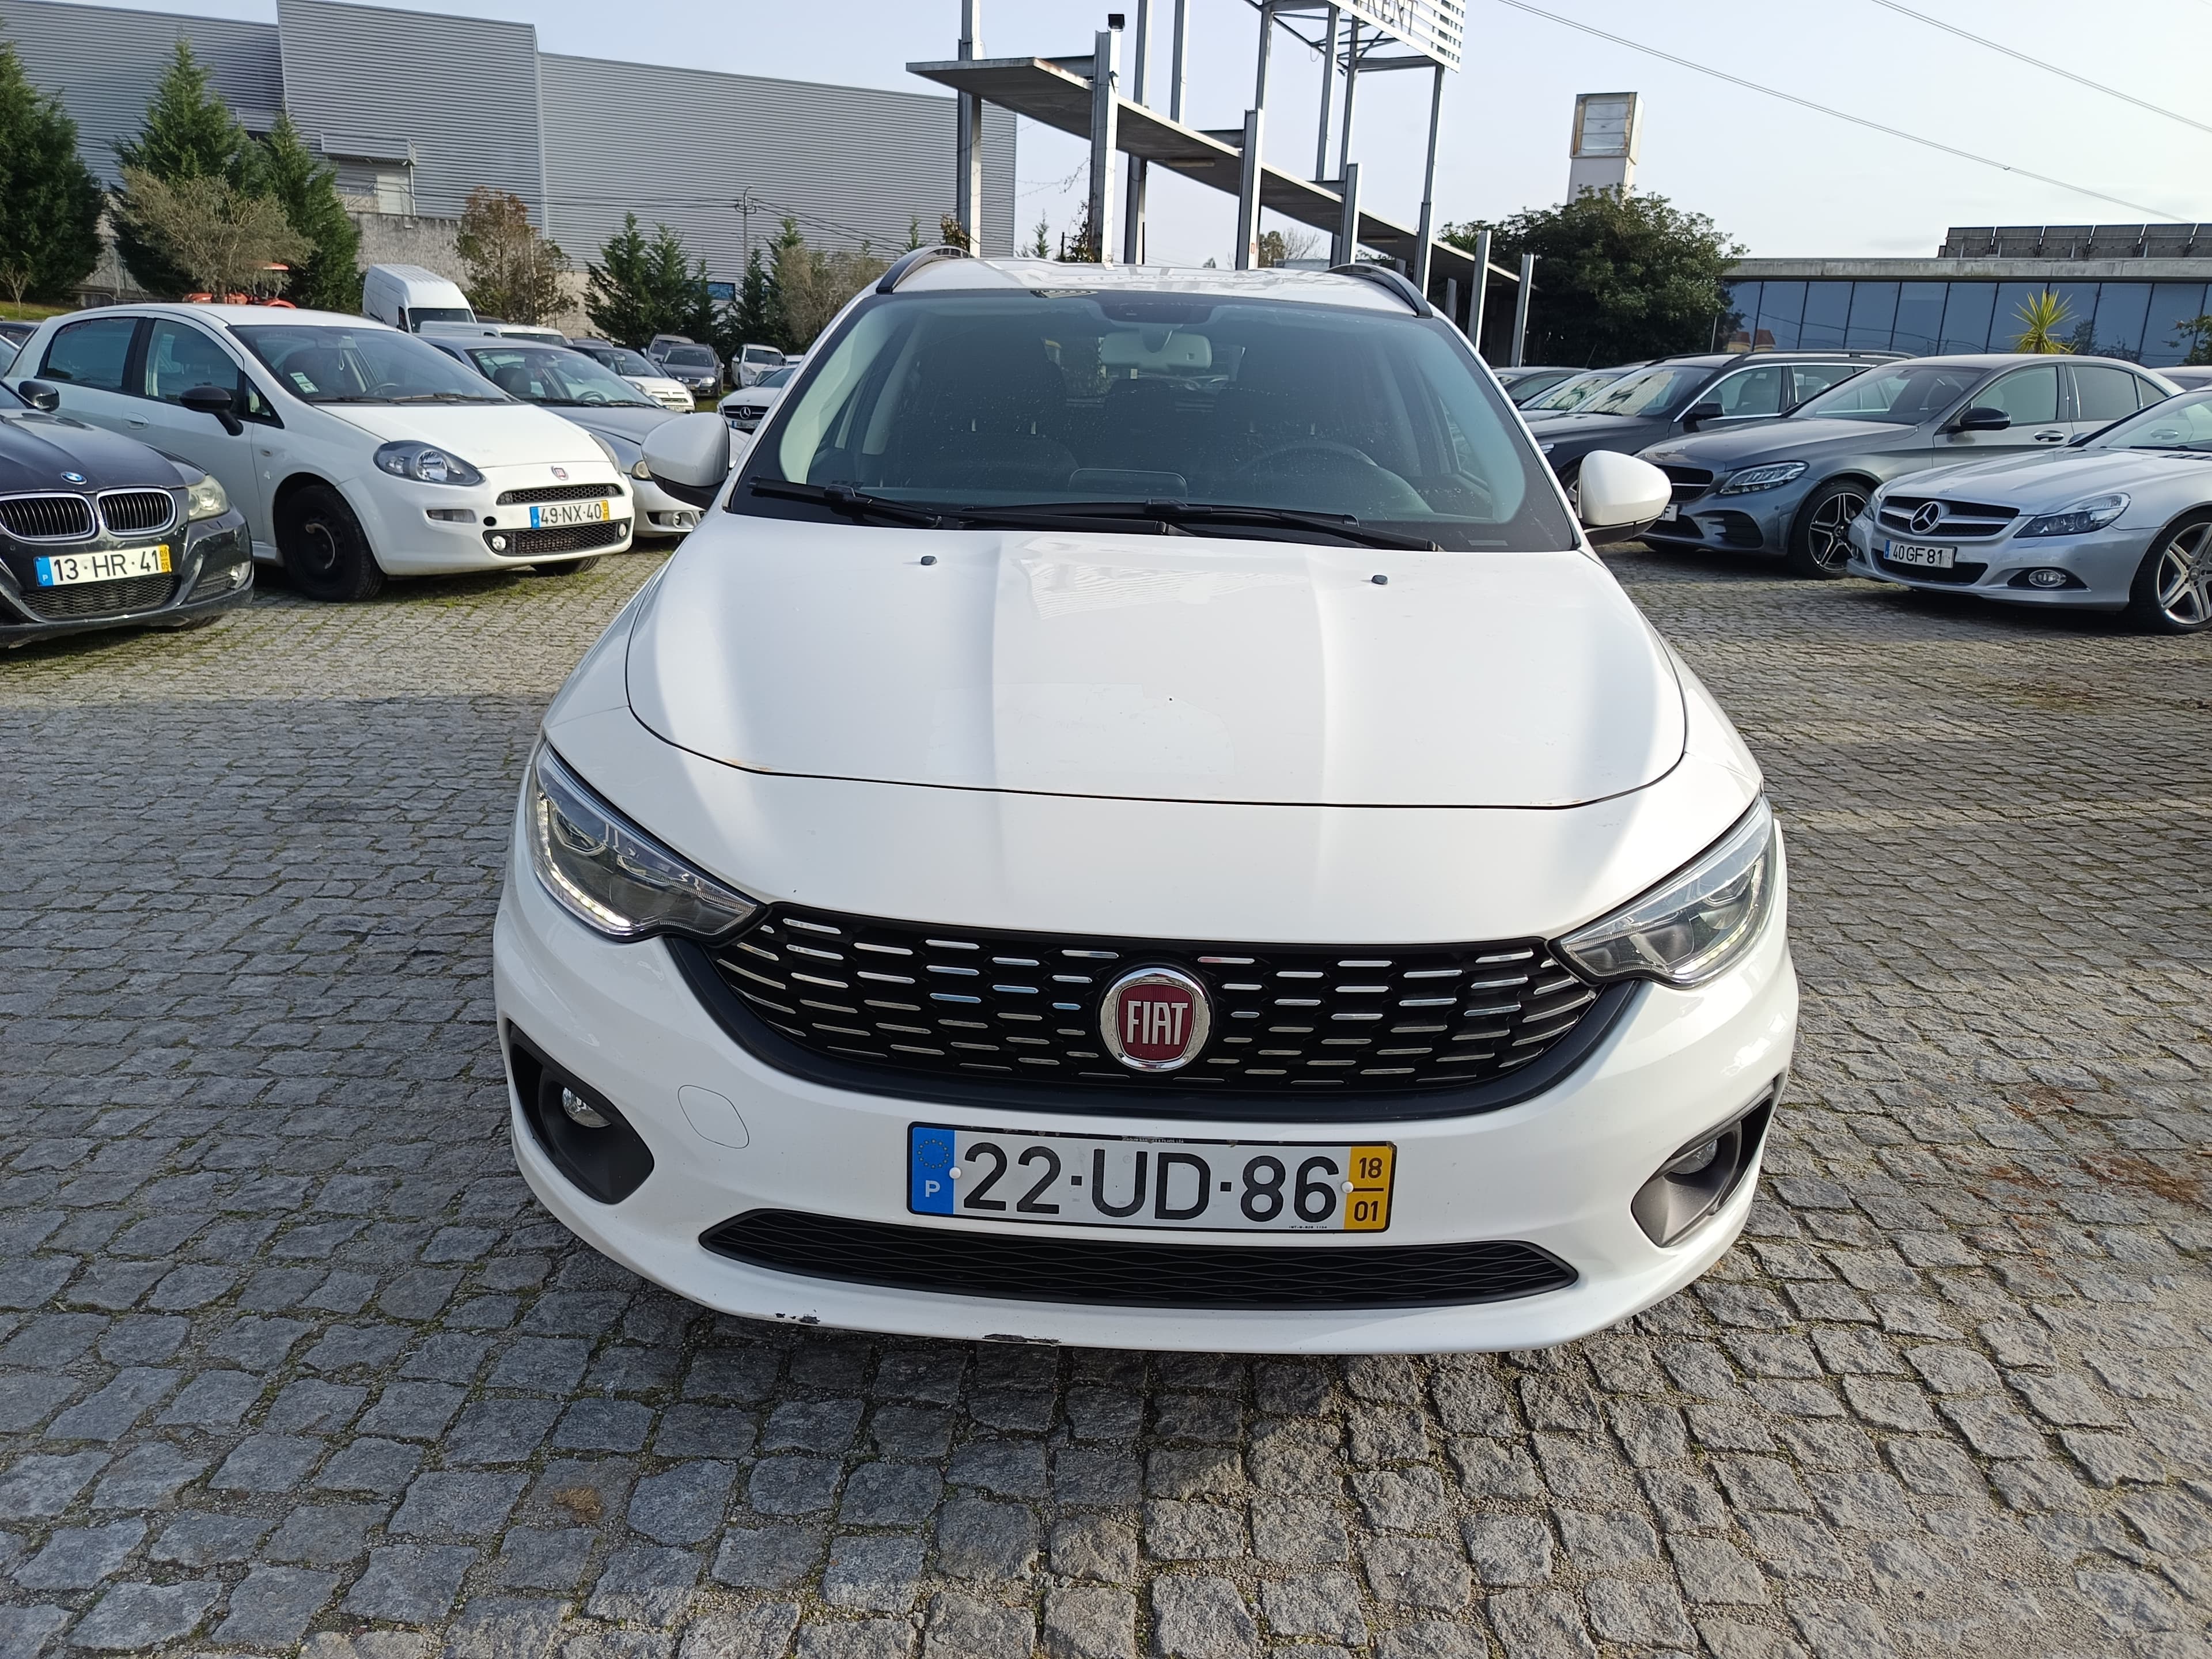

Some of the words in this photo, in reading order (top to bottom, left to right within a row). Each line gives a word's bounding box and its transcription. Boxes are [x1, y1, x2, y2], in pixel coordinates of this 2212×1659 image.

[1127, 1000, 1188, 1045] FIAT
[1359, 1157, 1382, 1179] 18
[925, 1180, 941, 1198] P
[963, 1142, 1339, 1223] 22·UD·86
[1354, 1200, 1378, 1221] 01
